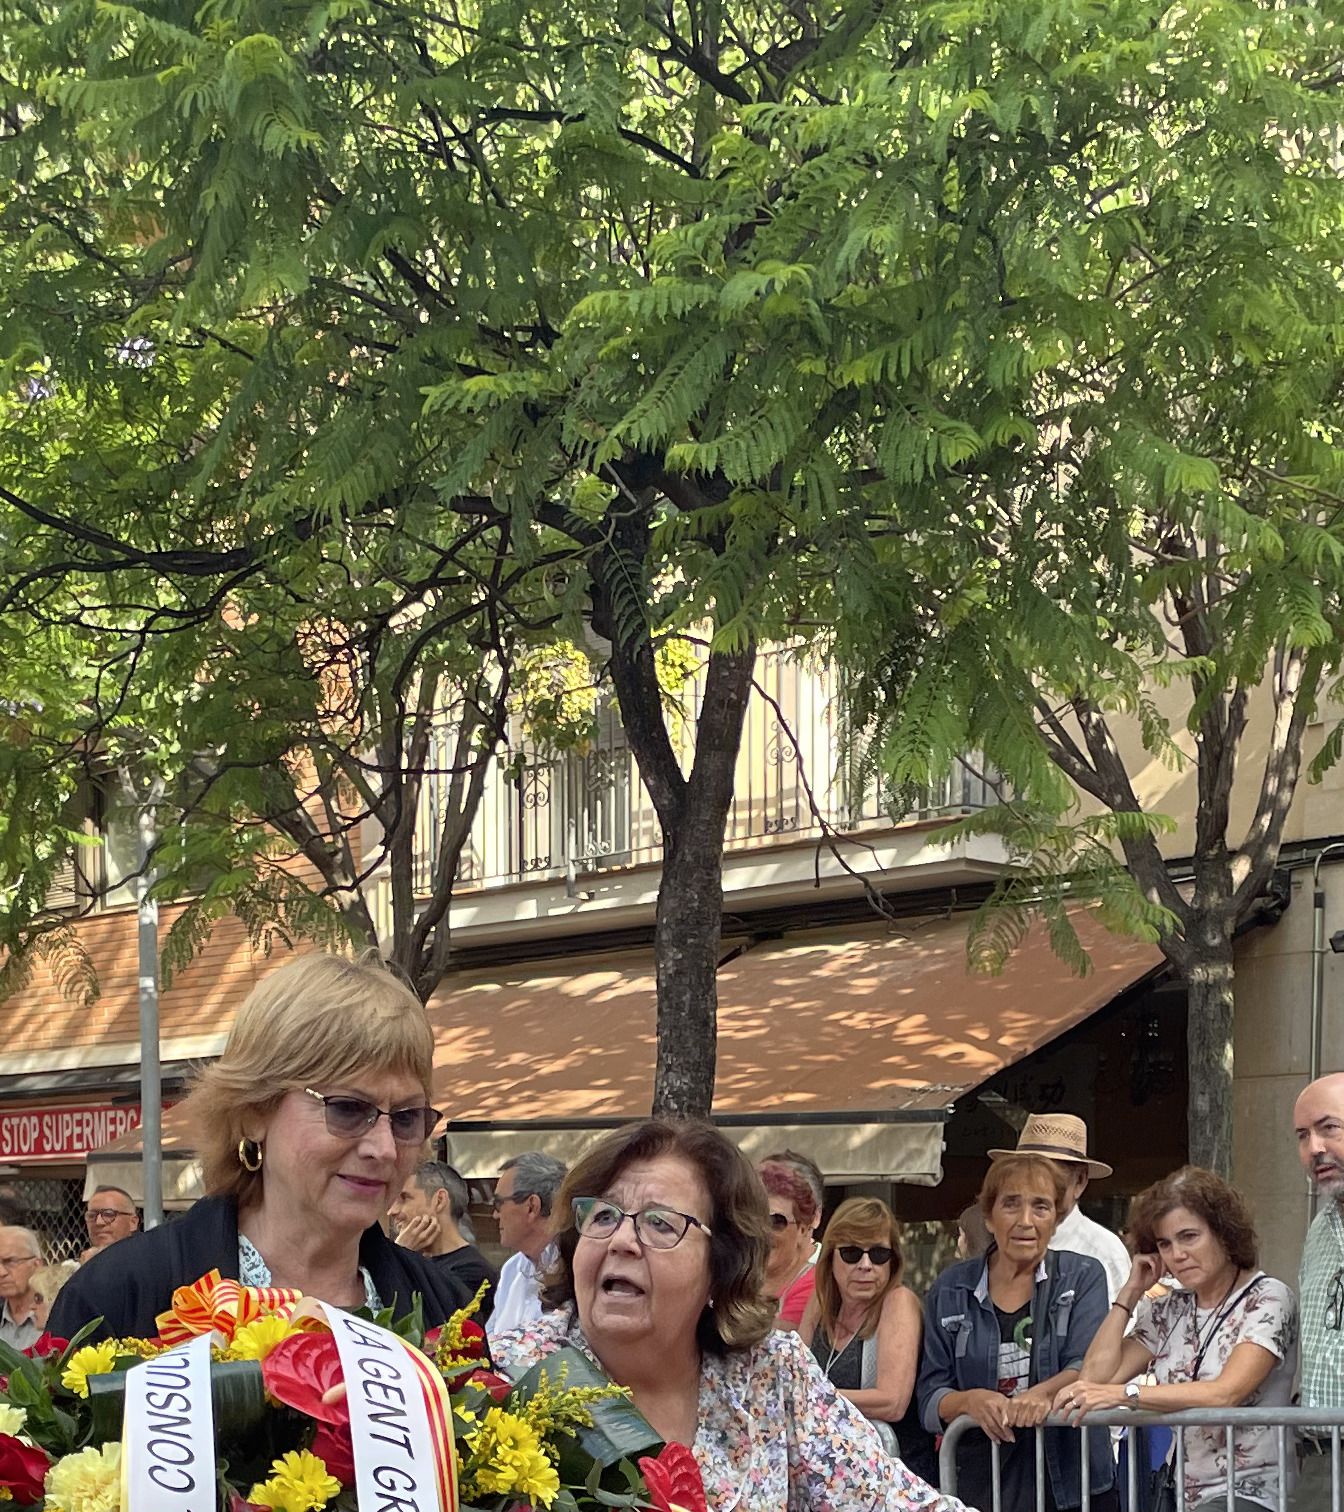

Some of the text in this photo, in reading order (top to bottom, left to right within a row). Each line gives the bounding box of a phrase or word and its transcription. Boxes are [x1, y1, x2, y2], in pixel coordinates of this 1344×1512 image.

[1, 1115, 40, 1155] STOP
[42, 1108, 143, 1152] SUPERMERC
[343, 1319, 393, 1352] LA
[357, 1357, 415, 1460] GENT
